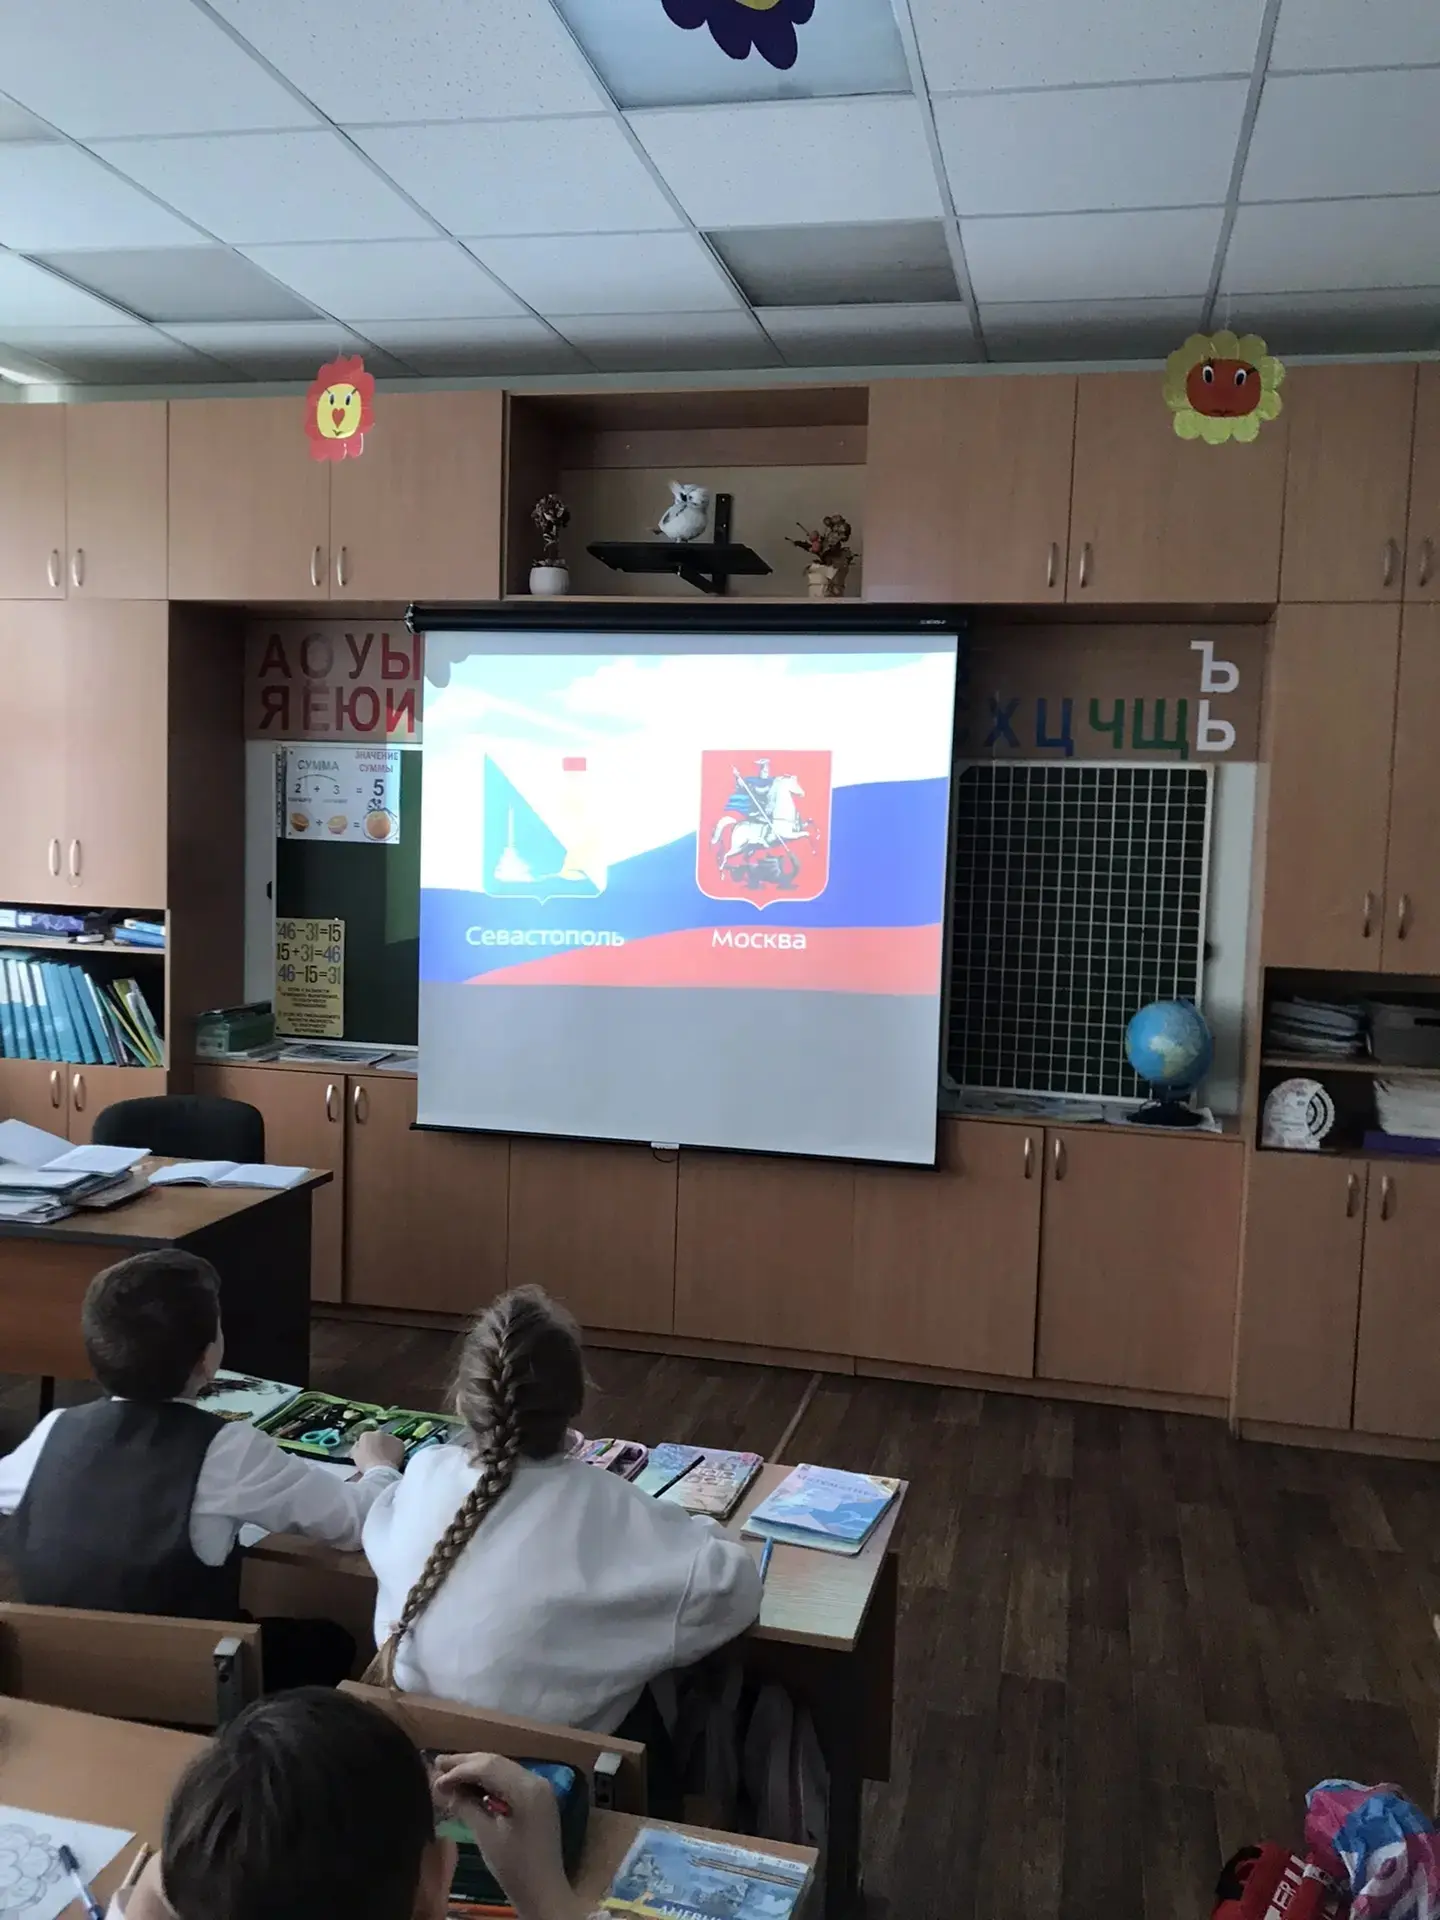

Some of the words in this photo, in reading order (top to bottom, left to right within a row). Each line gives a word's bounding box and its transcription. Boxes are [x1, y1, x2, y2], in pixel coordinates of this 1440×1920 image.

[1190, 641, 1240, 693] Ъ
[355, 750, 398, 761] ЗНАЧЕНИЕ
[297, 760, 340, 771] СУММА
[359, 764, 393, 773] СУММЫ
[294, 783, 301, 793] 2
[332, 784, 340, 795] 3
[373, 778, 384, 796] 5
[465, 926, 625, 947] Севастополь
[711, 928, 807, 950] Москва
